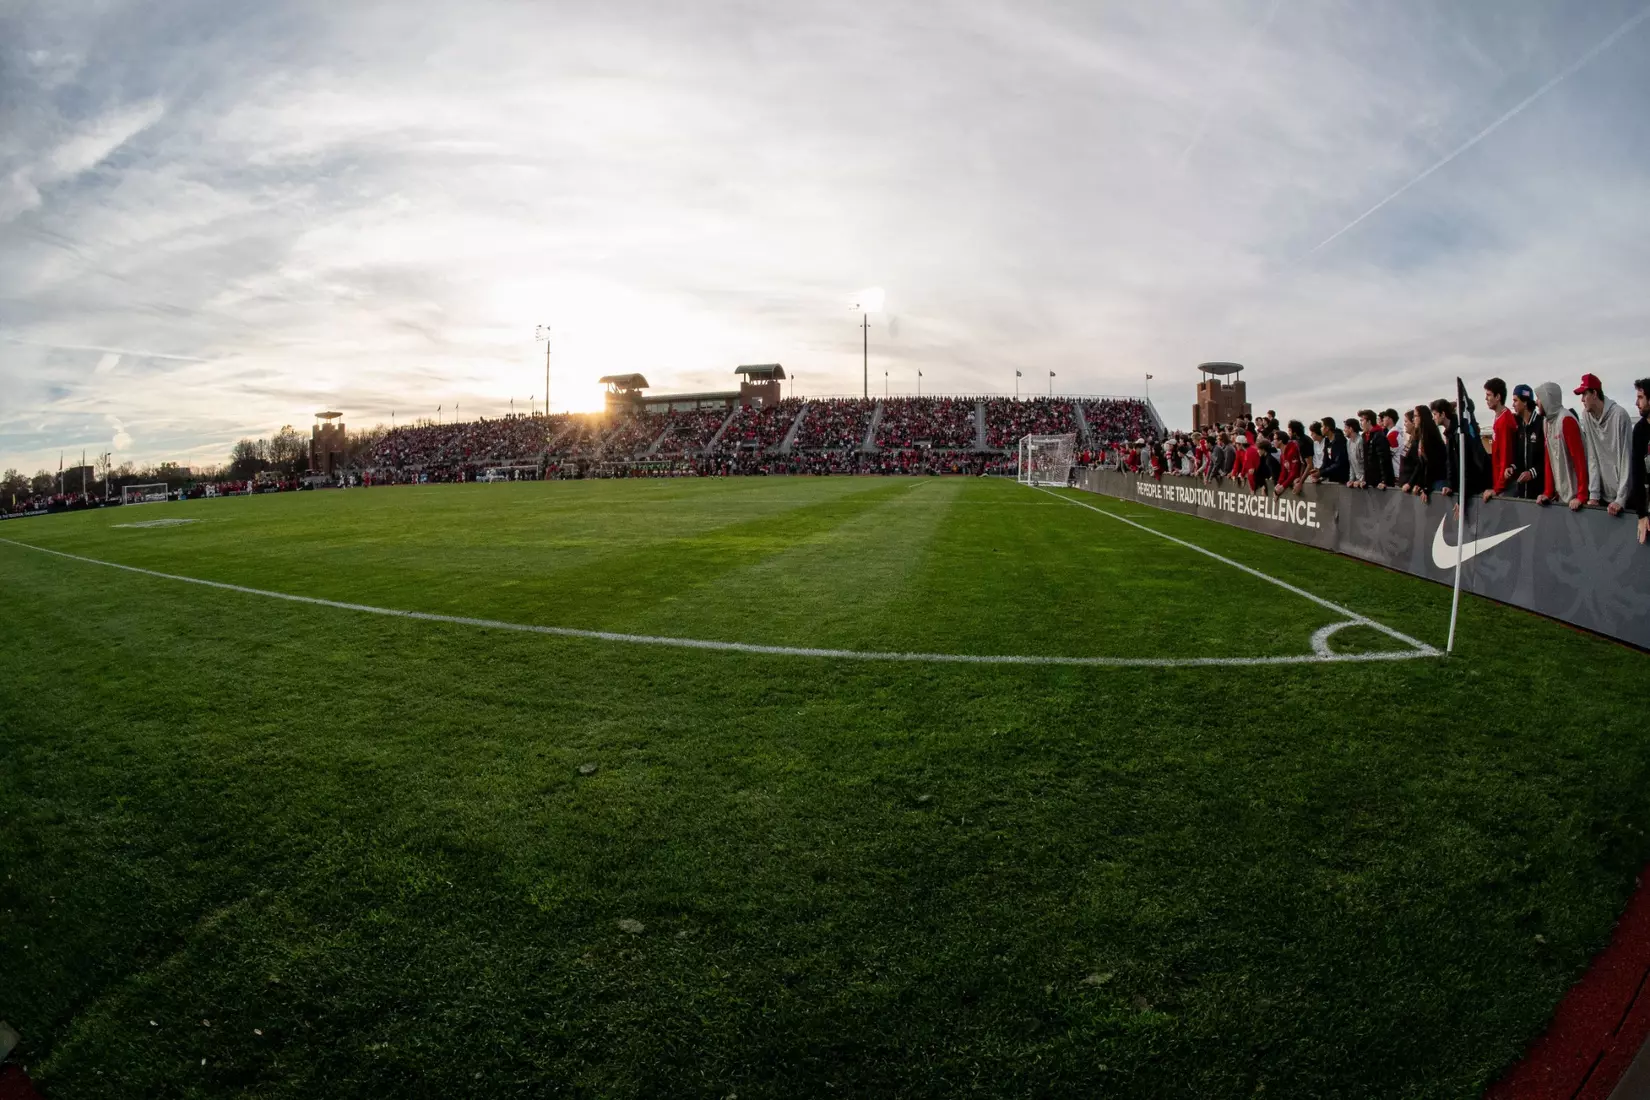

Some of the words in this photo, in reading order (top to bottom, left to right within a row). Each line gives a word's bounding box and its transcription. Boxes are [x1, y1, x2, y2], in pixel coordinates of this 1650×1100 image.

[1163, 485, 1175, 501] THE
[1175, 486, 1216, 508] TRADITION.
[1218, 491, 1236, 512] THE
[1237, 494, 1320, 529] EXCELLENCE.
